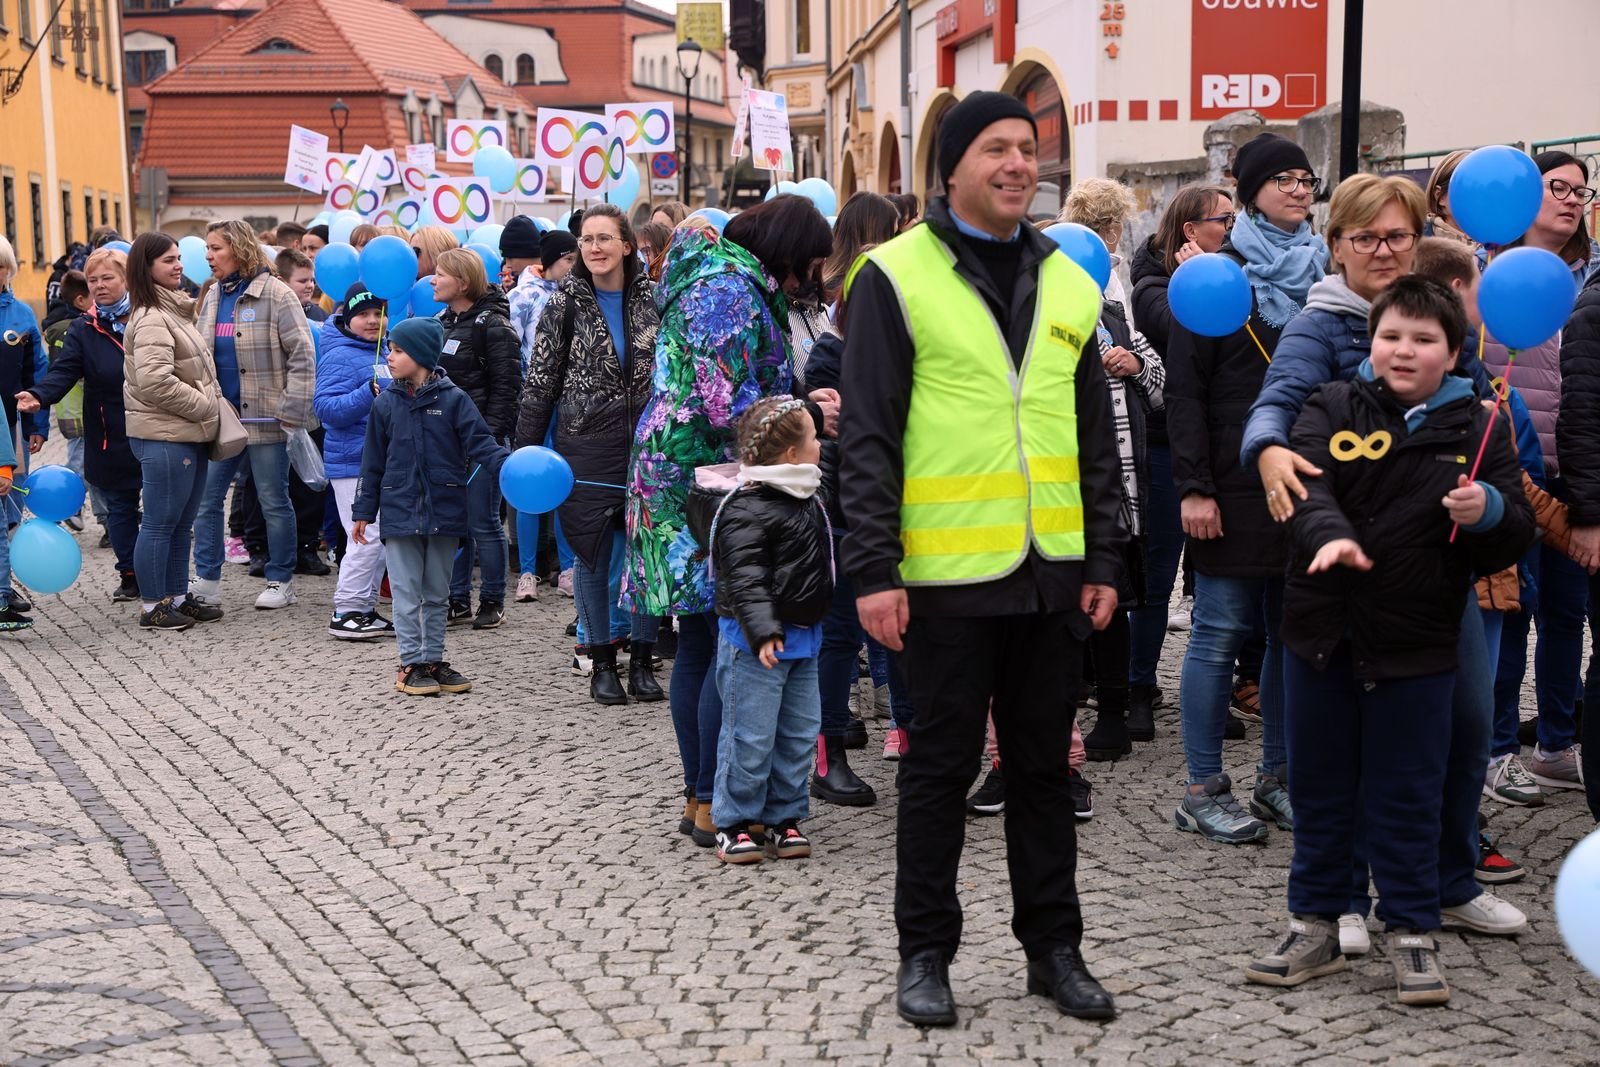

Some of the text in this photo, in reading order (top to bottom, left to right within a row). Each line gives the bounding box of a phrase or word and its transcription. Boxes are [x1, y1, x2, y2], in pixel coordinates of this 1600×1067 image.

[1100, 3, 1125, 21] 25
[1103, 23, 1122, 37] m
[1201, 73, 1282, 109] RED
[1400, 937, 1423, 945] NASA
